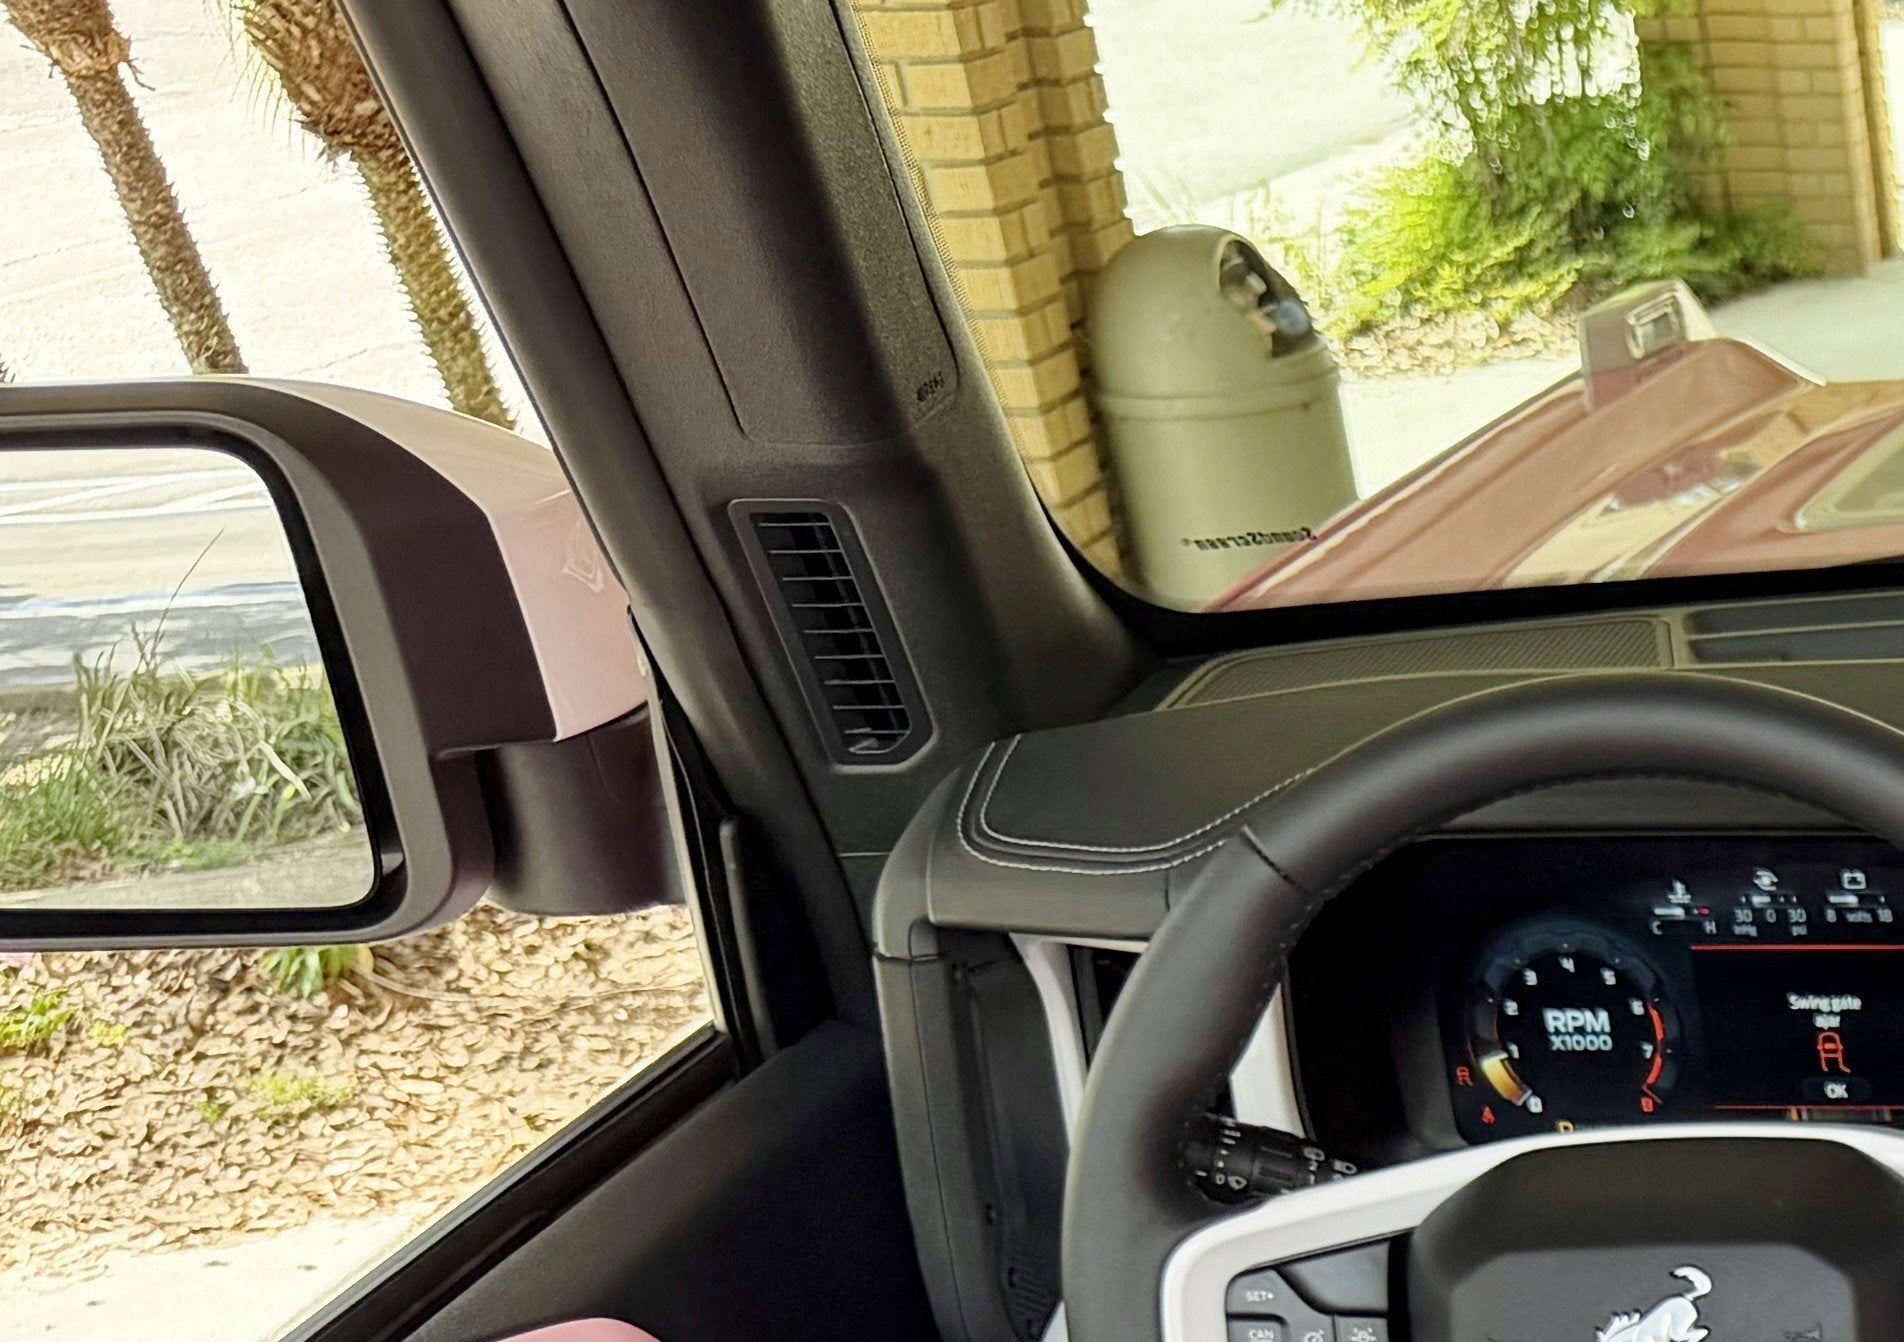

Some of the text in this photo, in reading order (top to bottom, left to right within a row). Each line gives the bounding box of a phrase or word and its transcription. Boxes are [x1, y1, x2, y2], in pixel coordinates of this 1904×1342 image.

[1543, 1006, 1612, 1034] RPM
[1549, 1034, 1614, 1051] X1000
[1824, 1081, 1850, 1099] OK
